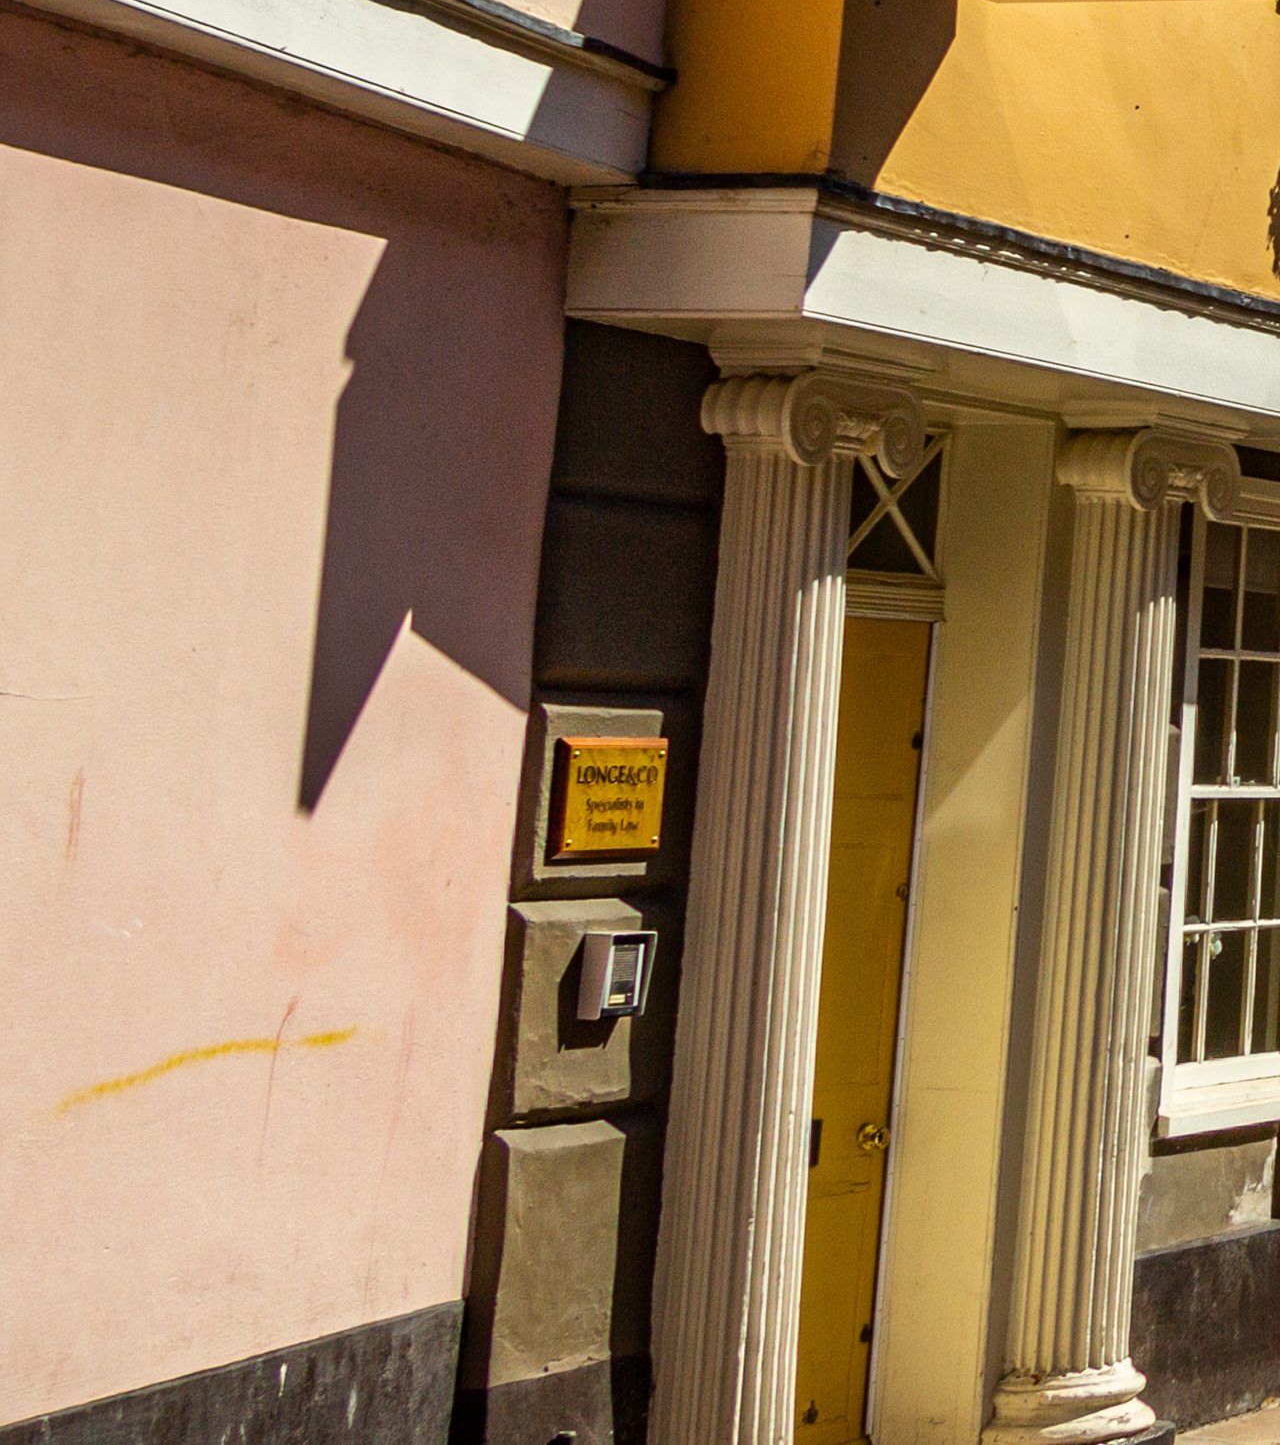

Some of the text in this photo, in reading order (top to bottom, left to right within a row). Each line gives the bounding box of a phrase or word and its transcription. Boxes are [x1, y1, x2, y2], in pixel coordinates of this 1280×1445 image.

[576, 765, 659, 786] LONGE&CO
[586, 797, 644, 814] Specialists in
[588, 818, 639, 835] Family Law
